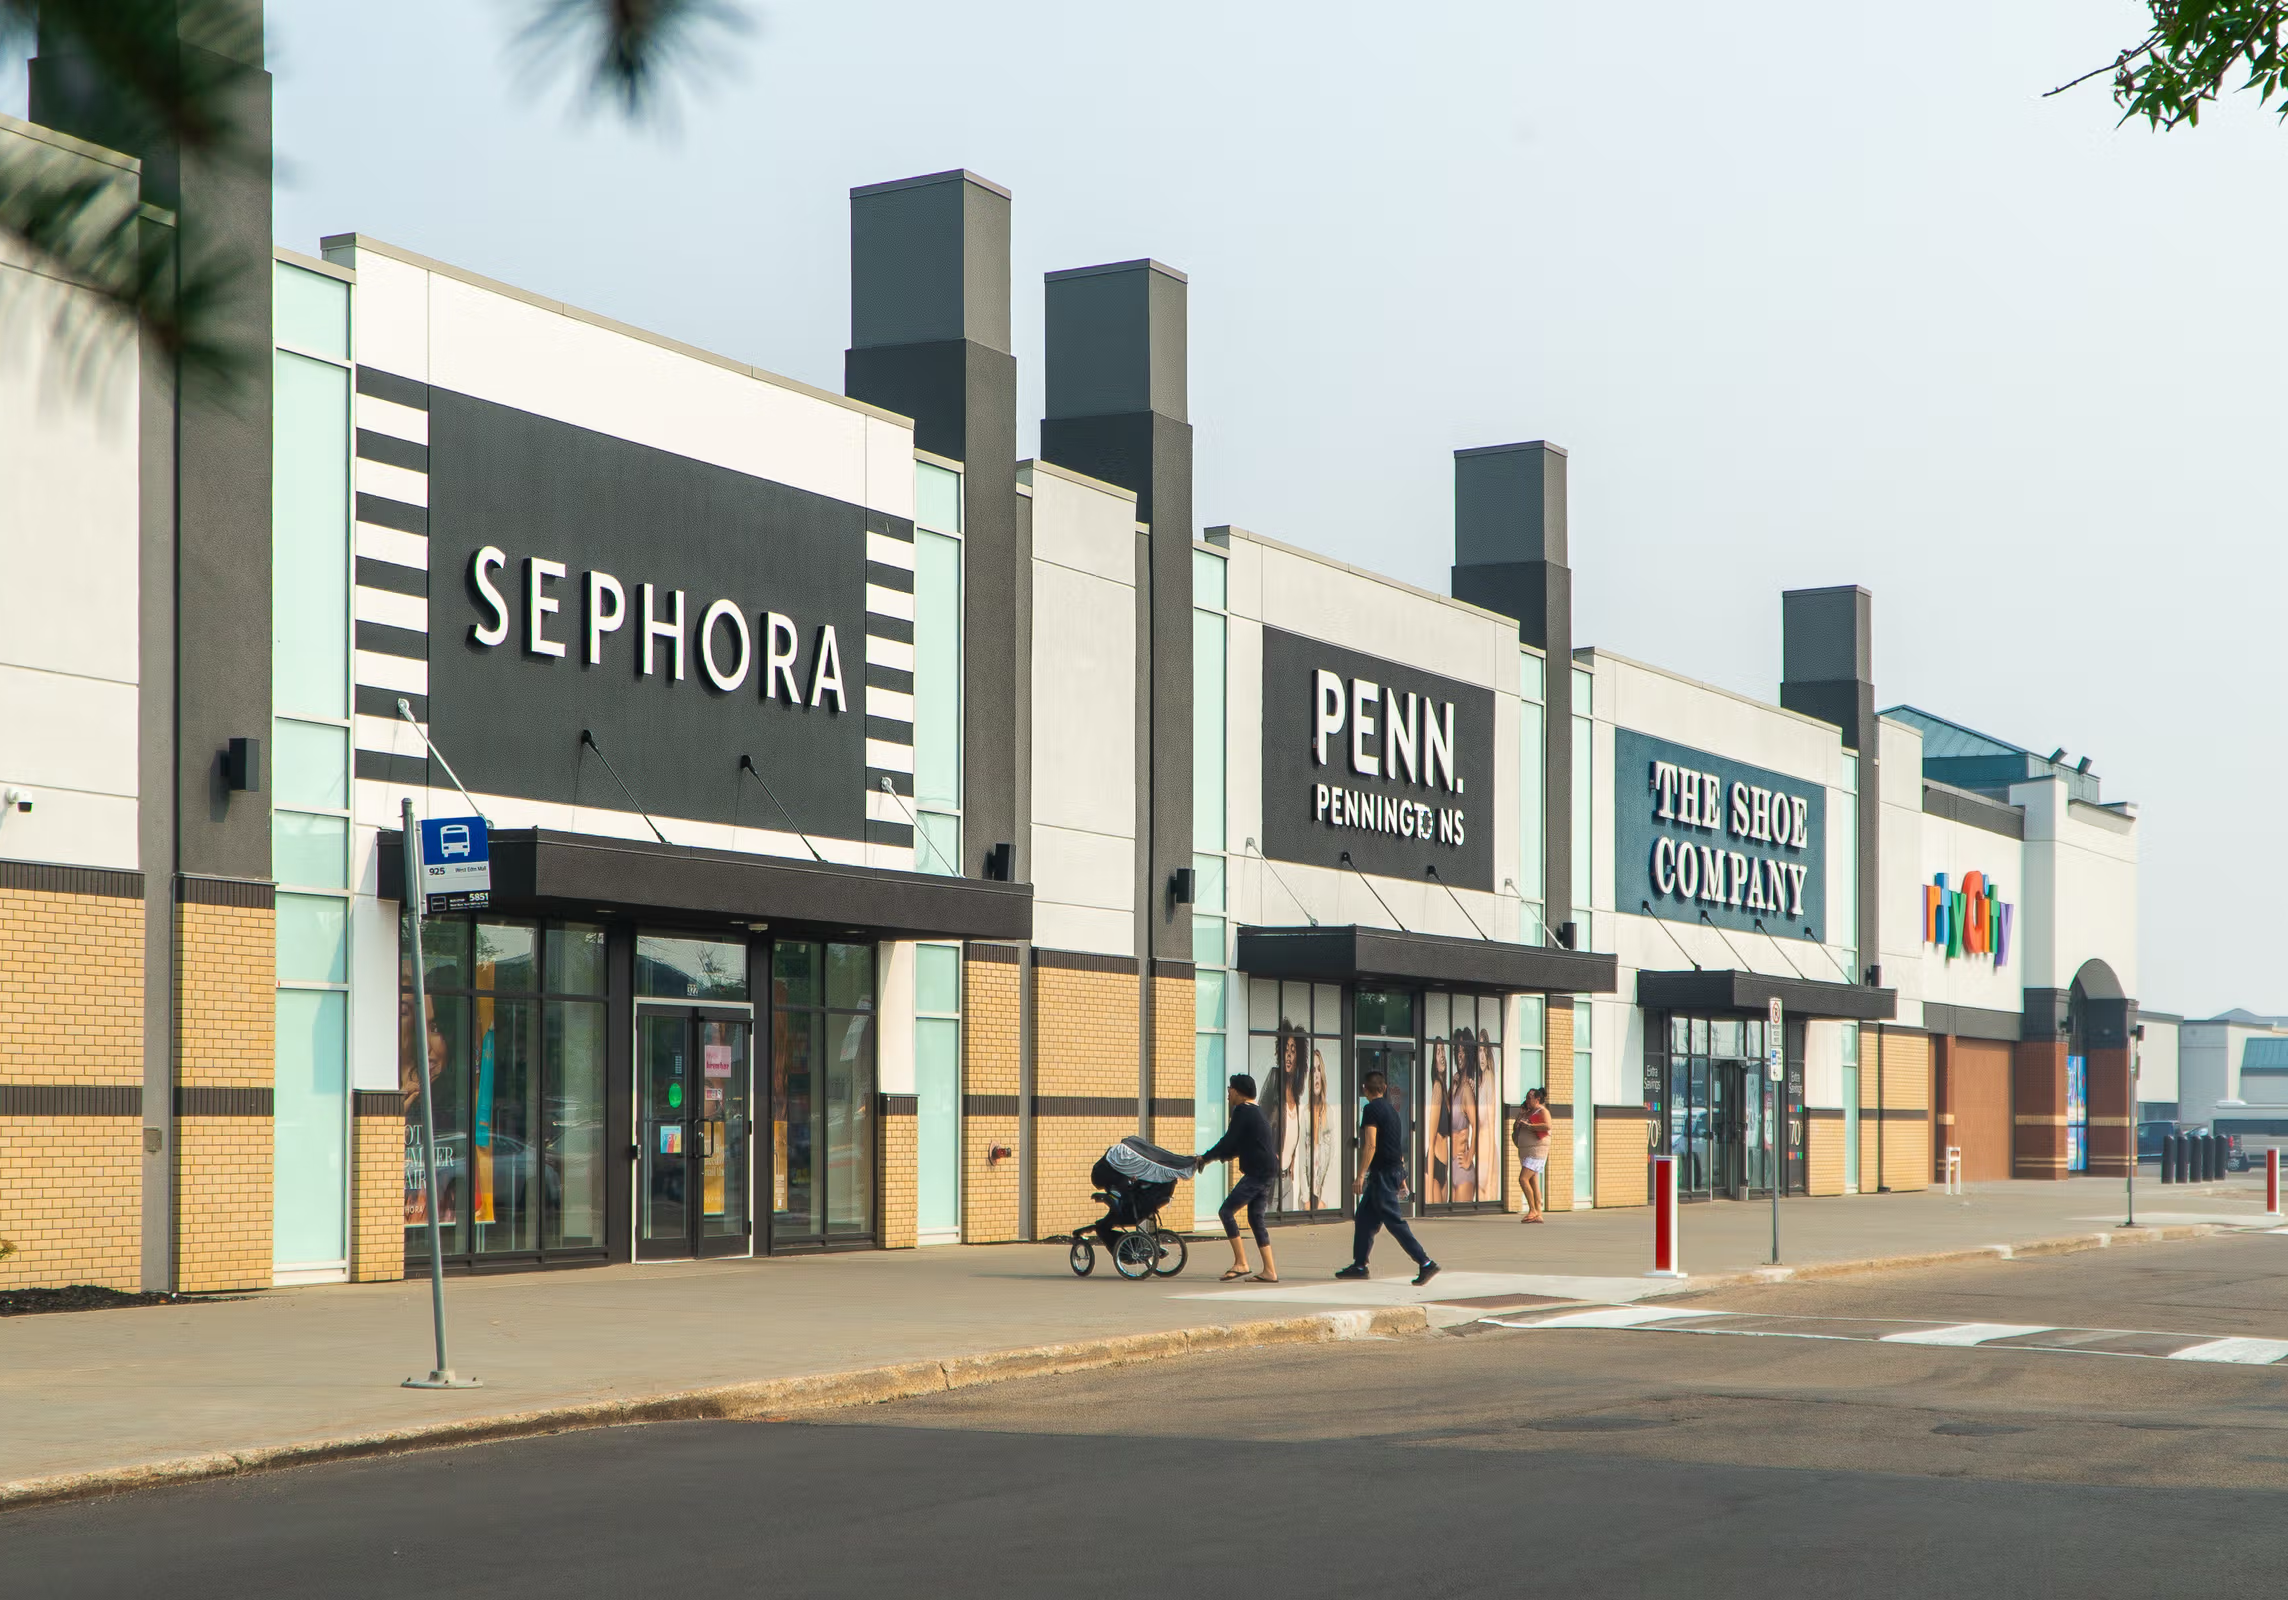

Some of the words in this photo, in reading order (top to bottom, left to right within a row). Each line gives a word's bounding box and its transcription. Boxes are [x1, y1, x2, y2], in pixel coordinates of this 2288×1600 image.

[467, 546, 848, 713] SEPHORA
[1313, 668, 1464, 794] PENN.
[1651, 760, 1721, 830] THE
[1729, 781, 1808, 849] SHOE
[428, 867, 446, 876] 925
[1653, 836, 1808, 916] COMPANY
[469, 892, 489, 902] 5851
[1922, 870, 2014, 967] rtyCity
[1646, 1064, 1658, 1077] Extra
[1644, 1078, 1661, 1093] Savings
[404, 1124, 423, 1146] OT
[404, 1169, 427, 1190] AIR
